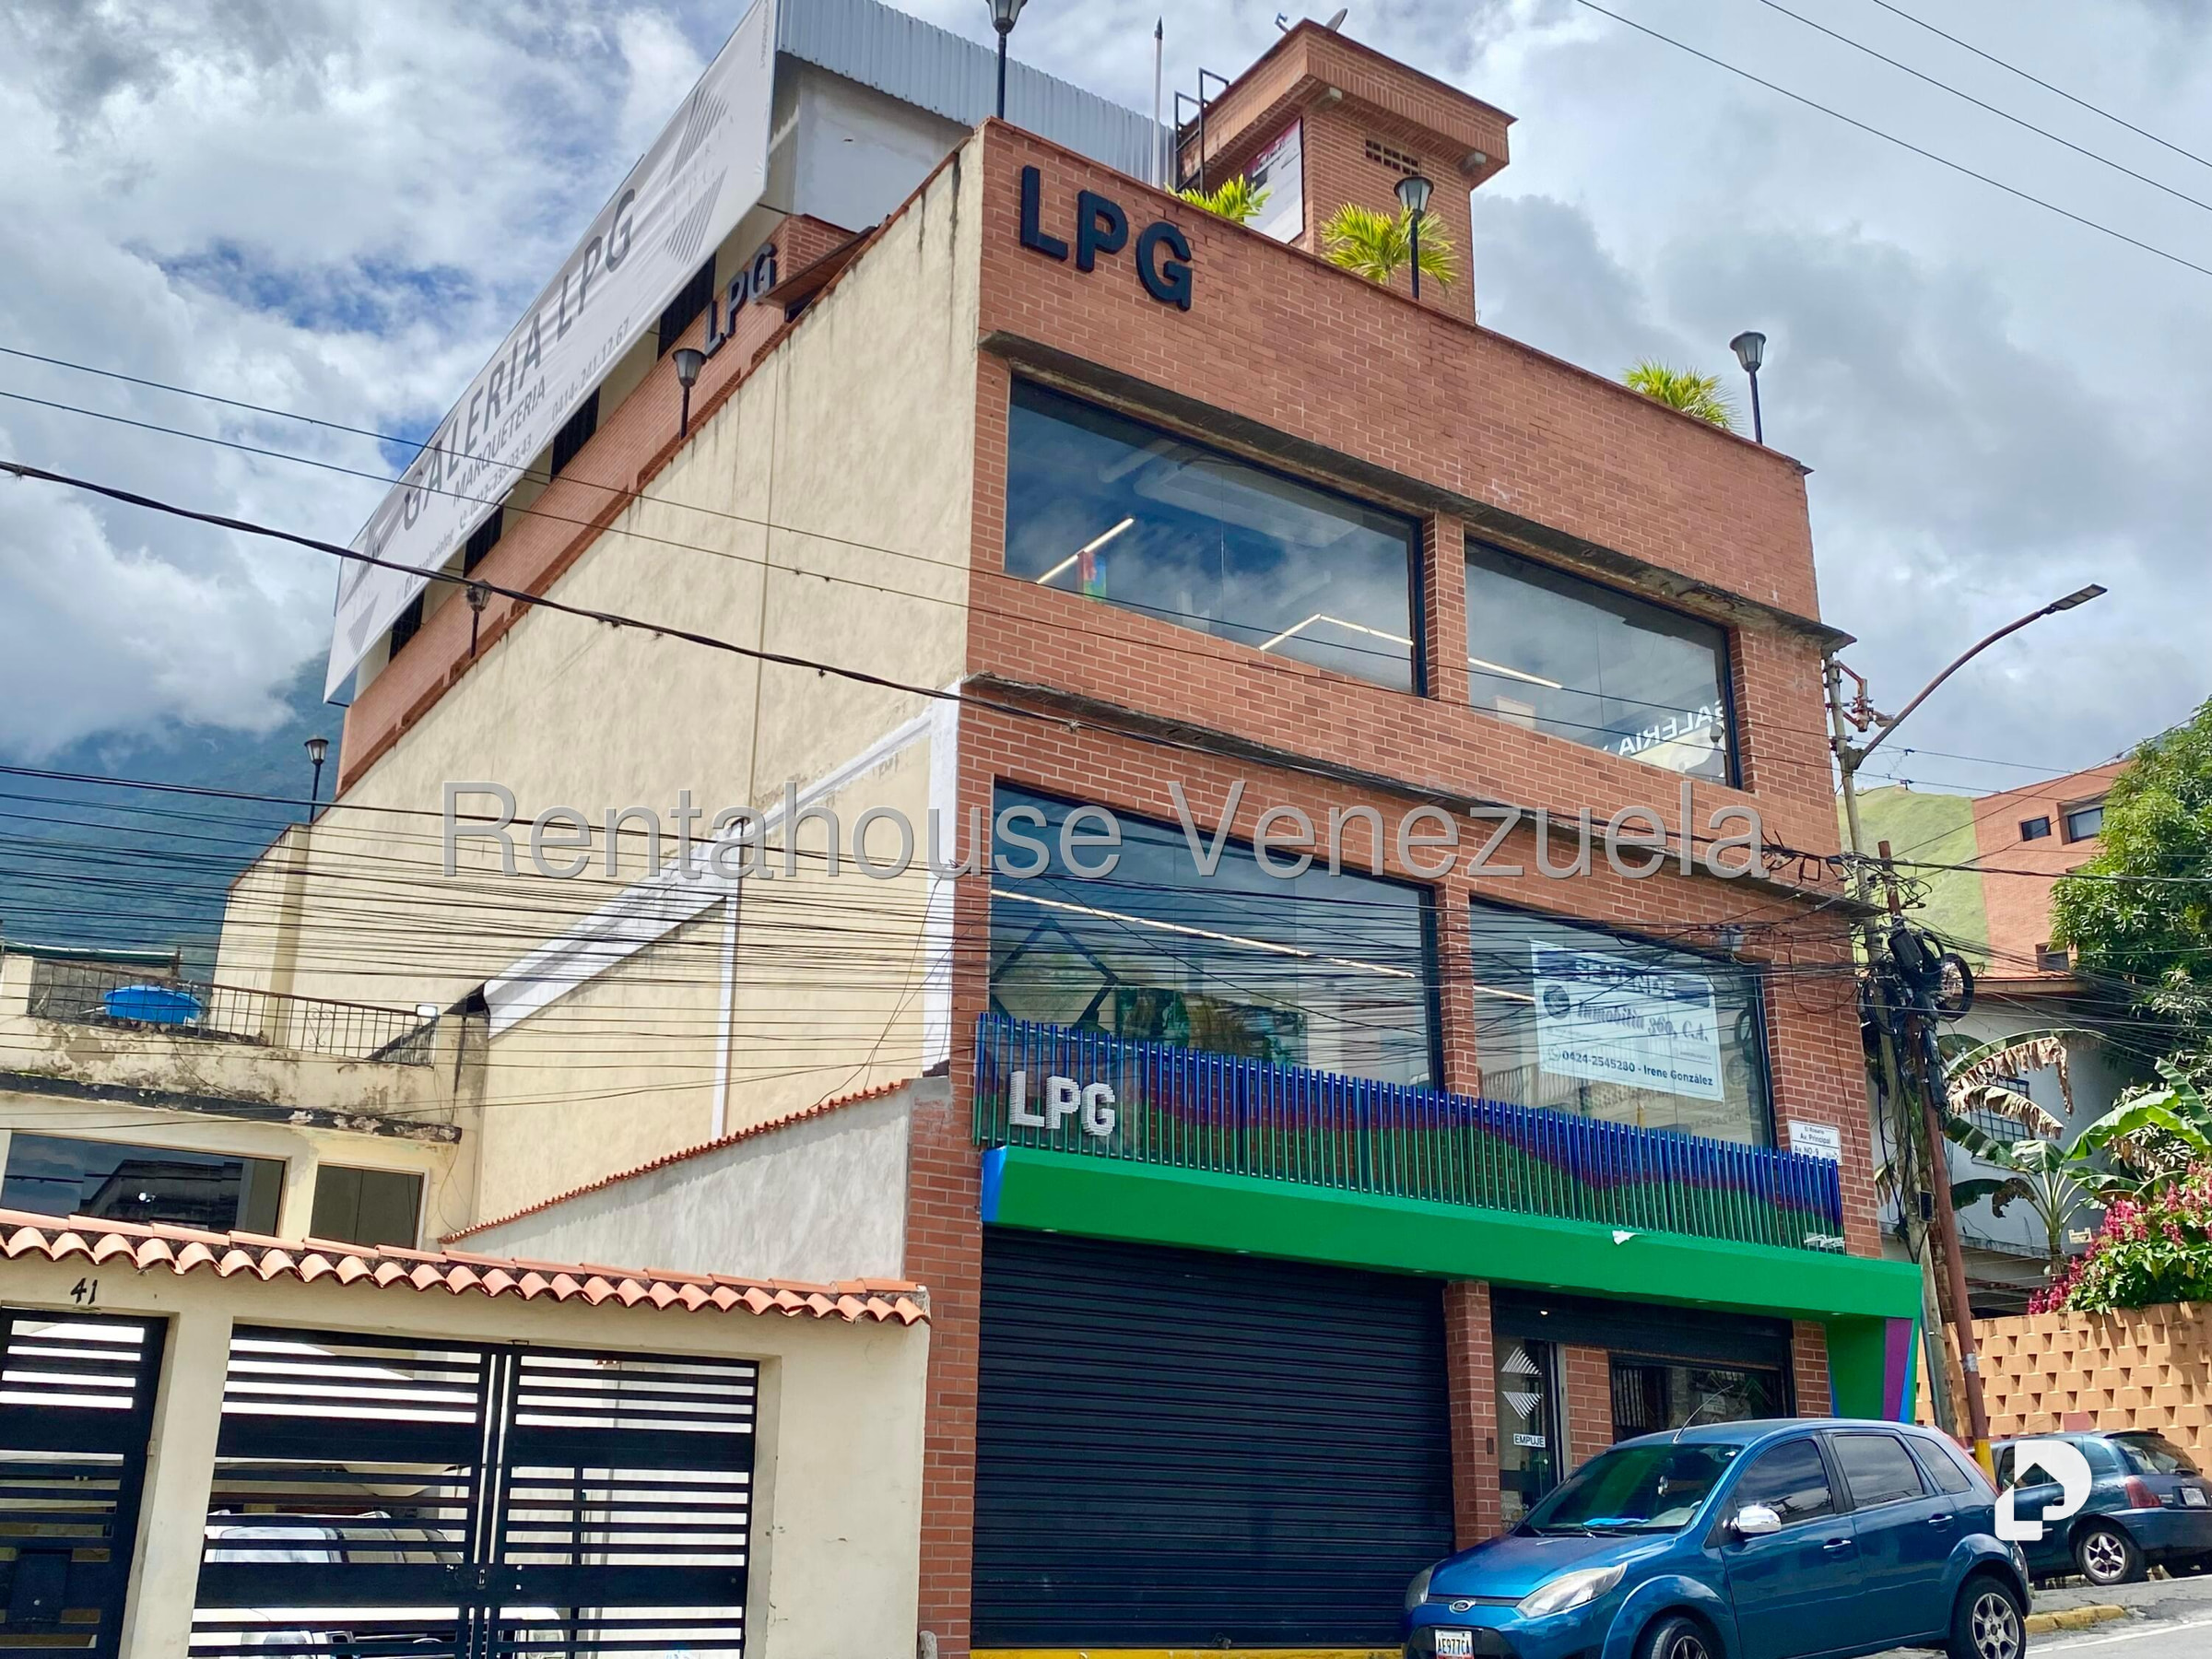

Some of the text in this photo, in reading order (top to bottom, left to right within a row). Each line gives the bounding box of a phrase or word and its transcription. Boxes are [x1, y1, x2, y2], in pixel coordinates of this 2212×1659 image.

[1019, 165, 1194, 312] LPG
[705, 241, 778, 360] LPG
[403, 187, 636, 531] GALERIA LPG
[453, 374, 547, 509] MARQUETERIA
[1562, 1050, 1636, 1073] 0424-2545280
[1643, 1065, 1668, 1078] Irene
[1670, 1069, 1713, 1087] González
[1009, 1070, 1116, 1137] LPG
[1808, 1134, 1831, 1145] Principal
[70, 1277, 99, 1305] 41
[1514, 1434, 1545, 1446] EMPUJE
[1438, 1638, 1470, 1655] AE977CA
